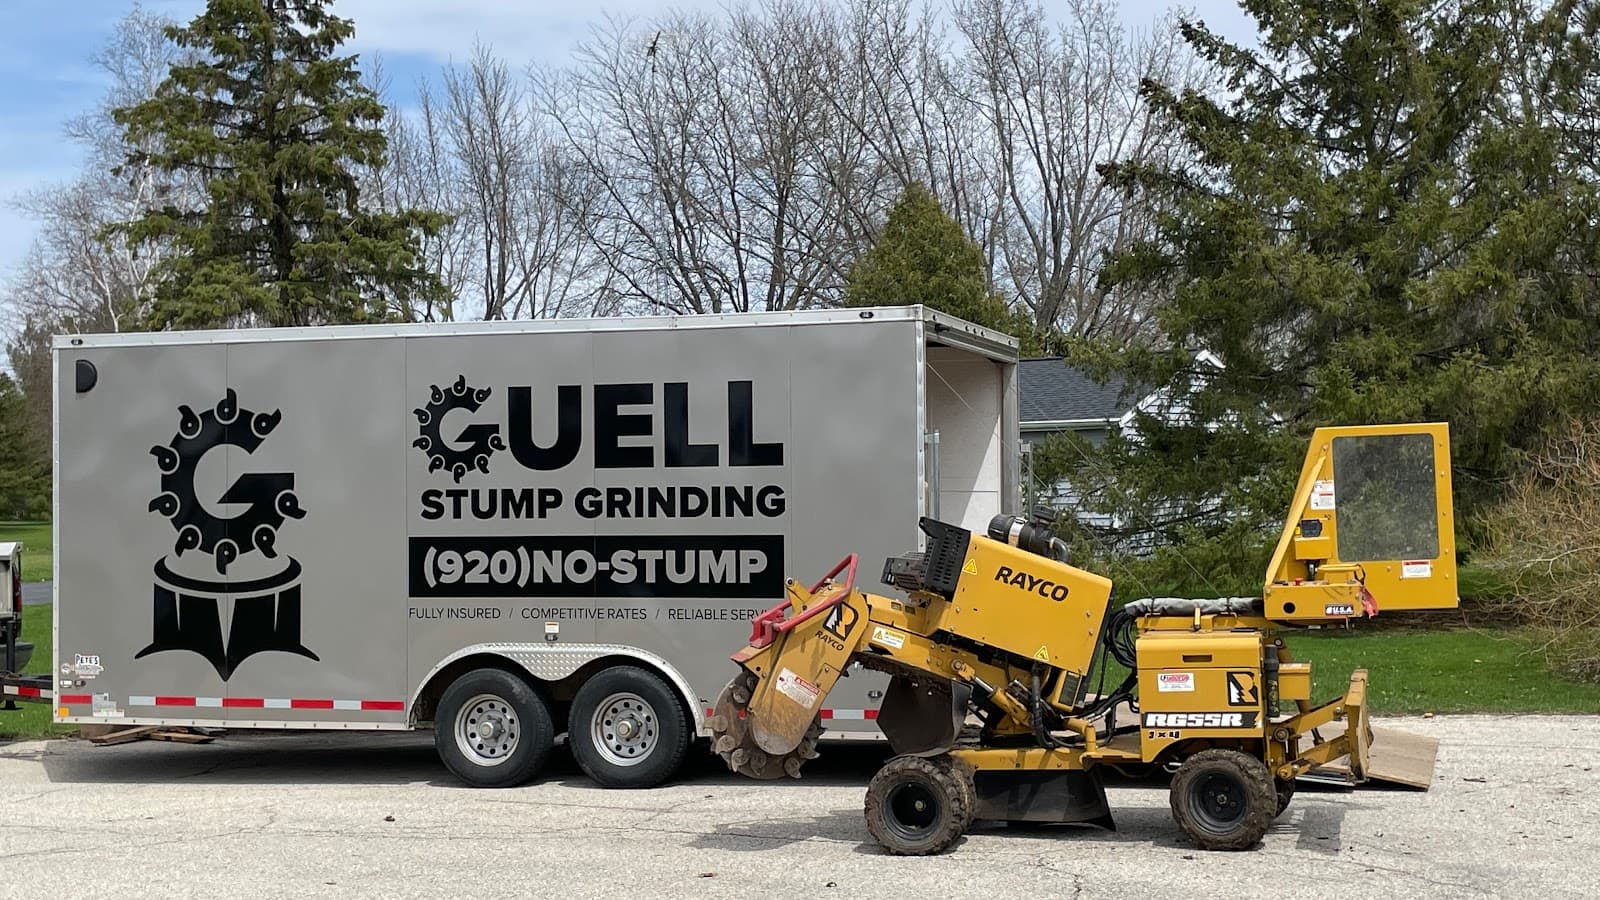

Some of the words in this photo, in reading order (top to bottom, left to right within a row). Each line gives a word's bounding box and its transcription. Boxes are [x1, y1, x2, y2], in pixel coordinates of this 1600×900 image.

[413, 374, 784, 484] GUELL
[420, 488, 563, 520] STUMP
[574, 485, 786, 519] GRINDING
[424, 546, 768, 588] (920)NO-STUMP
[994, 566, 1069, 602] RAYCO
[408, 608, 443, 619] FULLY
[447, 607, 501, 619] INSURED
[521, 607, 604, 620] COMPETITIVE
[607, 607, 647, 620] RATES
[668, 608, 727, 620] RELIABLE
[815, 630, 845, 651] RAYCO
